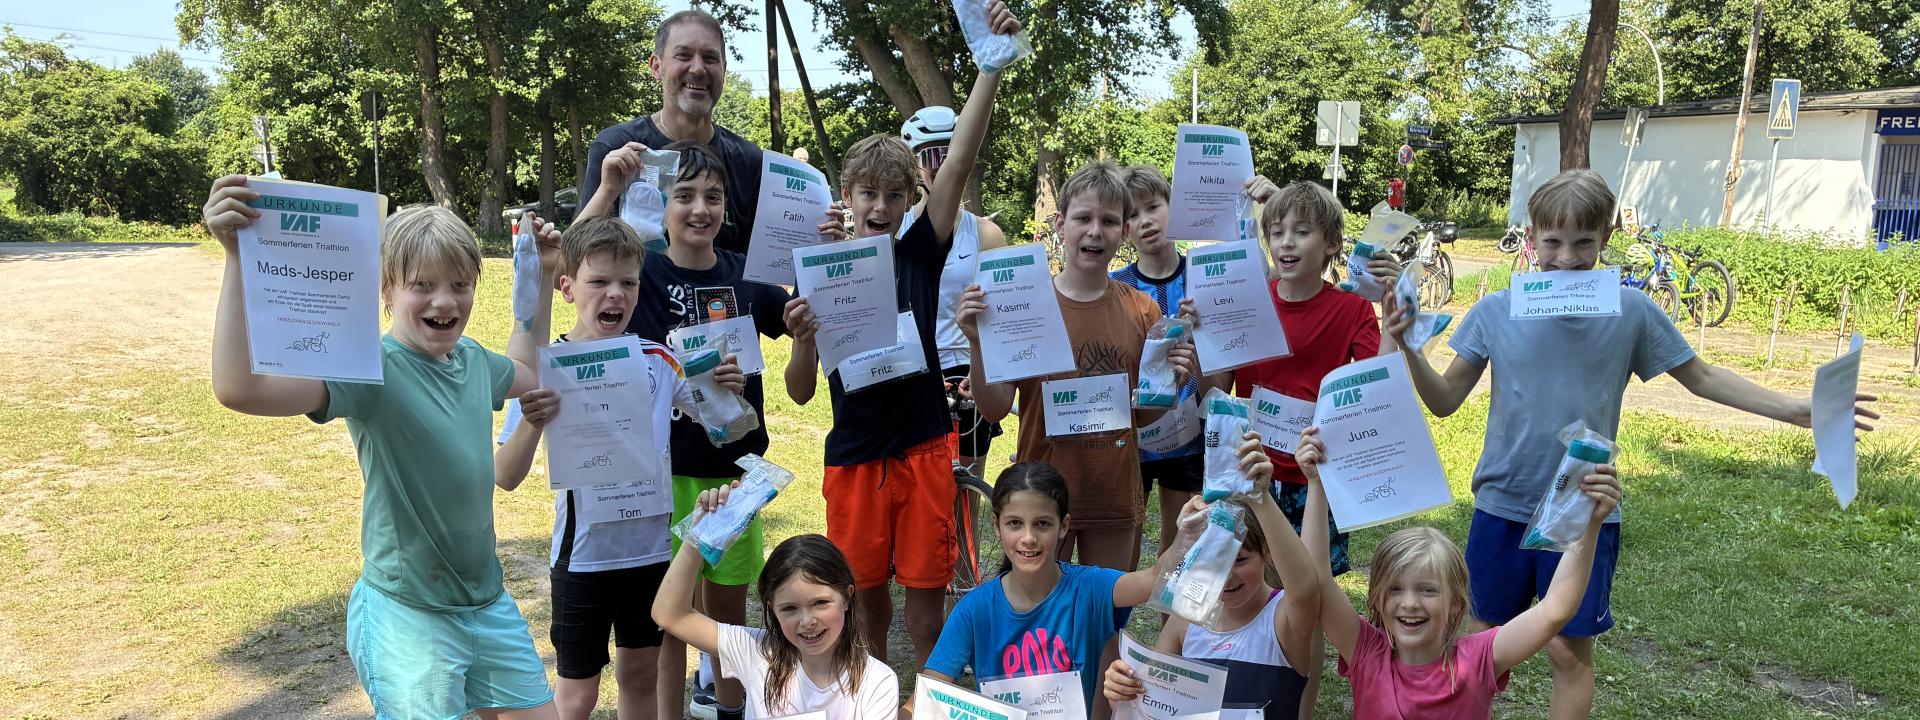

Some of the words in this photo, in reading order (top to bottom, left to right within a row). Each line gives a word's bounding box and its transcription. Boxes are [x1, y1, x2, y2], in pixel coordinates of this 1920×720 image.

[1202, 144, 1224, 155] VAF
[786, 176, 807, 192] VAF
[1200, 175, 1225, 185] Nikita
[264, 197, 343, 214] URKUNDE
[280, 212, 320, 233] VAF
[783, 210, 805, 223] Fatih
[257, 237, 313, 249] Sommerferien
[316, 242, 350, 252] Triathlon
[813, 250, 866, 265] URKUNDE
[257, 260, 354, 283] Mads-Jesper
[826, 262, 853, 278] VAF
[992, 268, 1015, 283] VAF
[1205, 263, 1226, 277] VAF
[813, 280, 851, 292] Sommerferien
[852, 276, 875, 285] Triathlon
[1523, 280, 1552, 291] VAF
[834, 296, 857, 305] Fritz
[996, 302, 1030, 313] Kasimir
[1213, 295, 1234, 306] Levi
[1523, 304, 1599, 315] Johan-Niklas
[682, 335, 707, 350] VAF
[563, 350, 619, 365] URKUNDE
[576, 363, 605, 380] VAF
[870, 365, 893, 378] Fritz
[1052, 390, 1077, 403] VAF
[1332, 387, 1362, 408] VAF
[582, 402, 609, 413] Tom
[1257, 399, 1281, 416] VAF
[1320, 410, 1362, 425] Sommerferien
[1364, 403, 1391, 414] Triathlon
[1069, 422, 1105, 432] Kasimir
[1140, 426, 1161, 440] VAF
[1211, 431, 1220, 448] RUN
[1348, 428, 1378, 442] Juna
[1268, 436, 1289, 450] Levi
[618, 508, 642, 519] Tom
[1148, 666, 1178, 683] VAF
[1172, 688, 1198, 701] Triathlon
[939, 693, 996, 719] URKUNDE
[1142, 694, 1179, 716] Emmy
